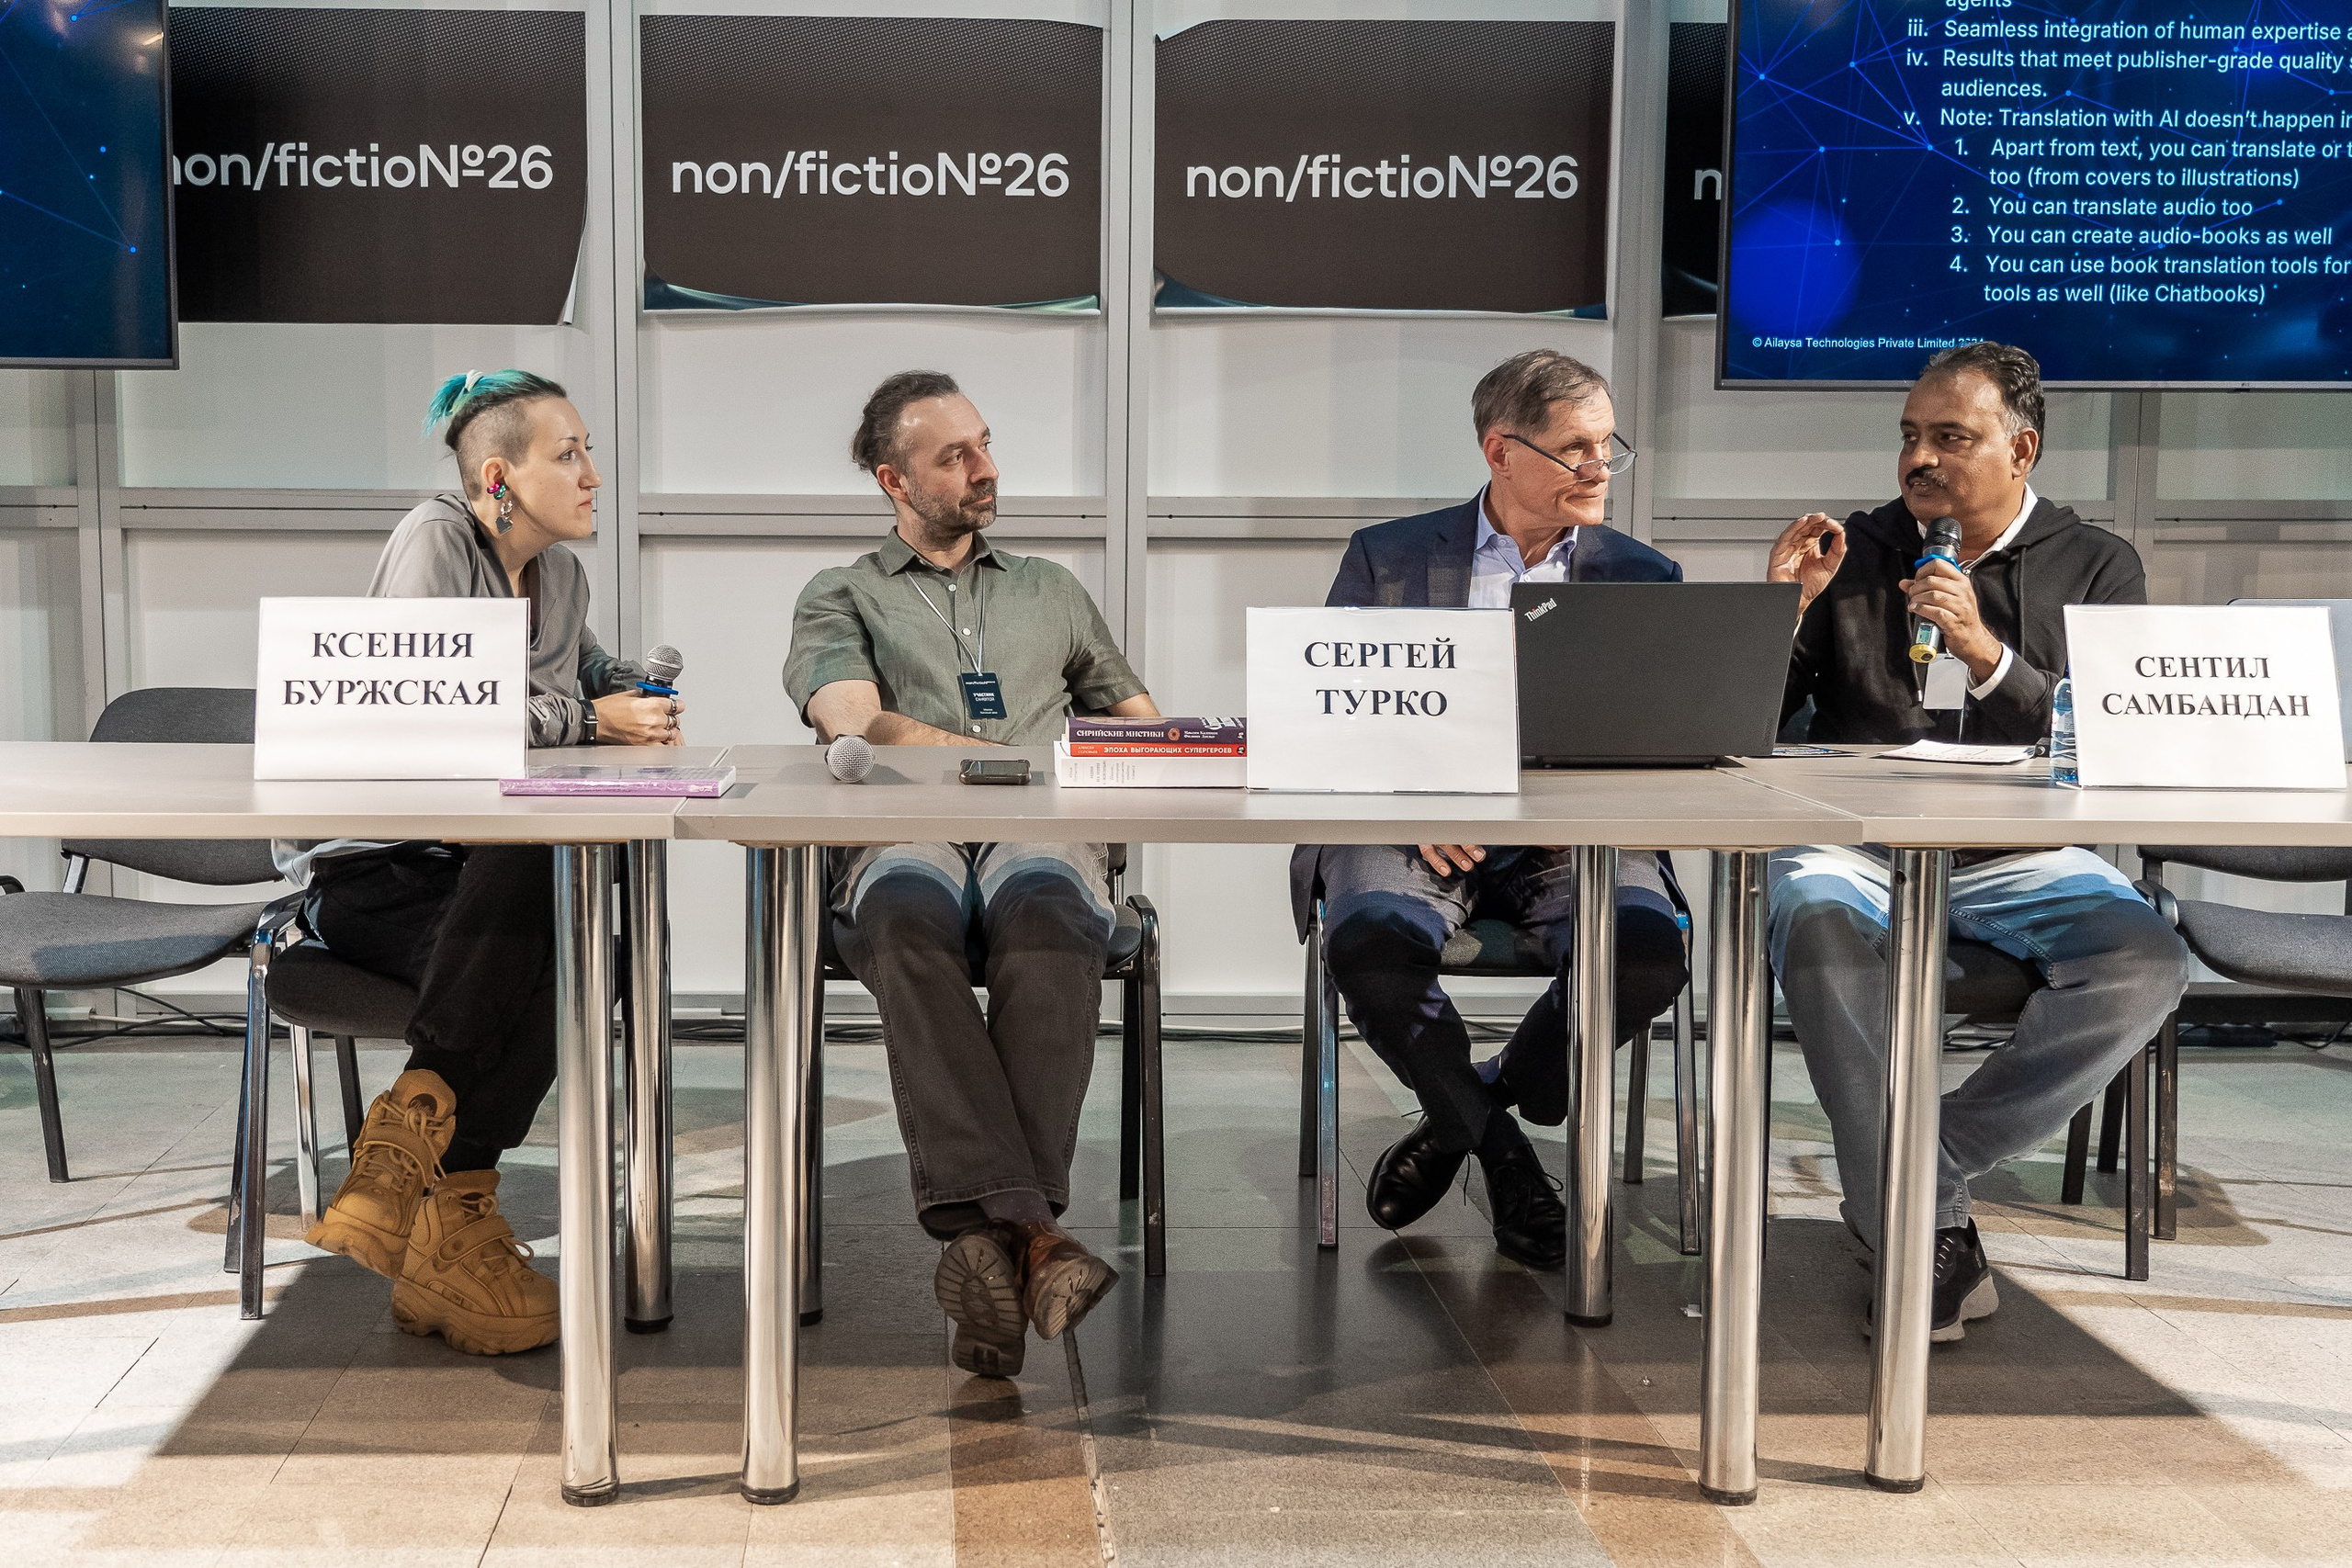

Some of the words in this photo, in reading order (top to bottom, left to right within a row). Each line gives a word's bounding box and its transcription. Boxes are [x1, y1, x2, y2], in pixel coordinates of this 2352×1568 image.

[1907, 18, 1928, 37] iii.
[1944, 19, 2039, 38] Seamless
[2044, 18, 2148, 42] integration
[2154, 20, 2176, 39] of
[2180, 21, 2245, 39] human
[2251, 21, 2341, 44] expertise
[1906, 48, 1928, 67] iv.
[1943, 49, 2014, 67] Results
[2019, 50, 2058, 68] that
[2064, 52, 2112, 68] meet
[2117, 51, 2273, 73] publisher-grade
[2278, 51, 2344, 73] quality
[1941, 78, 2047, 97] audiences.
[1904, 111, 1920, 126] v.
[1940, 107, 1993, 126] Note:
[1998, 107, 2107, 127] Translation
[2112, 108, 2154, 127] with
[2158, 109, 2179, 128] AI
[2262, 109, 2335, 132] happen
[1954, 138, 1969, 155] 1.
[1990, 139, 2045, 160] Apart
[2049, 138, 2095, 156] from
[2100, 140, 2143, 161] text,
[2149, 142, 2185, 162] you
[2190, 143, 2226, 158] can
[2231, 140, 2316, 158] translate
[2322, 143, 2342, 158] or
[1989, 168, 2021, 186] too
[2028, 166, 2079, 188] (from
[2085, 171, 2152, 186] covers
[2156, 169, 2176, 186] to
[2181, 167, 2299, 189] illustrations)
[1951, 197, 1970, 214] 2.
[1988, 197, 2027, 215] You
[2032, 200, 2067, 215] can
[2072, 197, 2157, 216] translate
[2163, 197, 2216, 216] audio
[2222, 198, 2253, 216] too
[1951, 226, 1969, 243] 3.
[1987, 226, 2025, 243] You
[2030, 230, 2065, 243] can
[2072, 228, 2133, 244] create
[2138, 226, 2260, 245] audio-books
[2266, 231, 2289, 245] as
[2293, 227, 2333, 245] well
[1949, 255, 1968, 273] 4.
[1985, 254, 2024, 273] You
[2030, 259, 2064, 273] can
[2070, 258, 2105, 274] use
[2110, 255, 2159, 274] book
[2163, 255, 2266, 274] translation
[2270, 256, 2318, 274] tools
[2323, 255, 2352, 274] for
[1984, 284, 2031, 301] tools
[2036, 288, 2059, 302] as
[2064, 284, 2103, 302] well
[2109, 284, 2149, 305] (like
[2154, 284, 2266, 305] Chatbooks)
[1764, 337, 1803, 350] Ailaysa
[1804, 337, 1875, 350] Technologies
[1878, 337, 1915, 348] Private
[1917, 337, 1955, 348] Limited
[1524, 597, 1557, 622] ThinkPad
[312, 632, 473, 659] КСЕНИЯ
[1304, 637, 1457, 670] СЕРГЕЙ
[2135, 656, 2270, 679] СЕНТИЛ
[283, 680, 500, 705] БУРЖСКАЯ
[1316, 689, 1448, 717] ТУРКО
[2102, 693, 2311, 720] САМБАНДАН
[1076, 729, 1125, 738] СИРИЙСКИЕ
